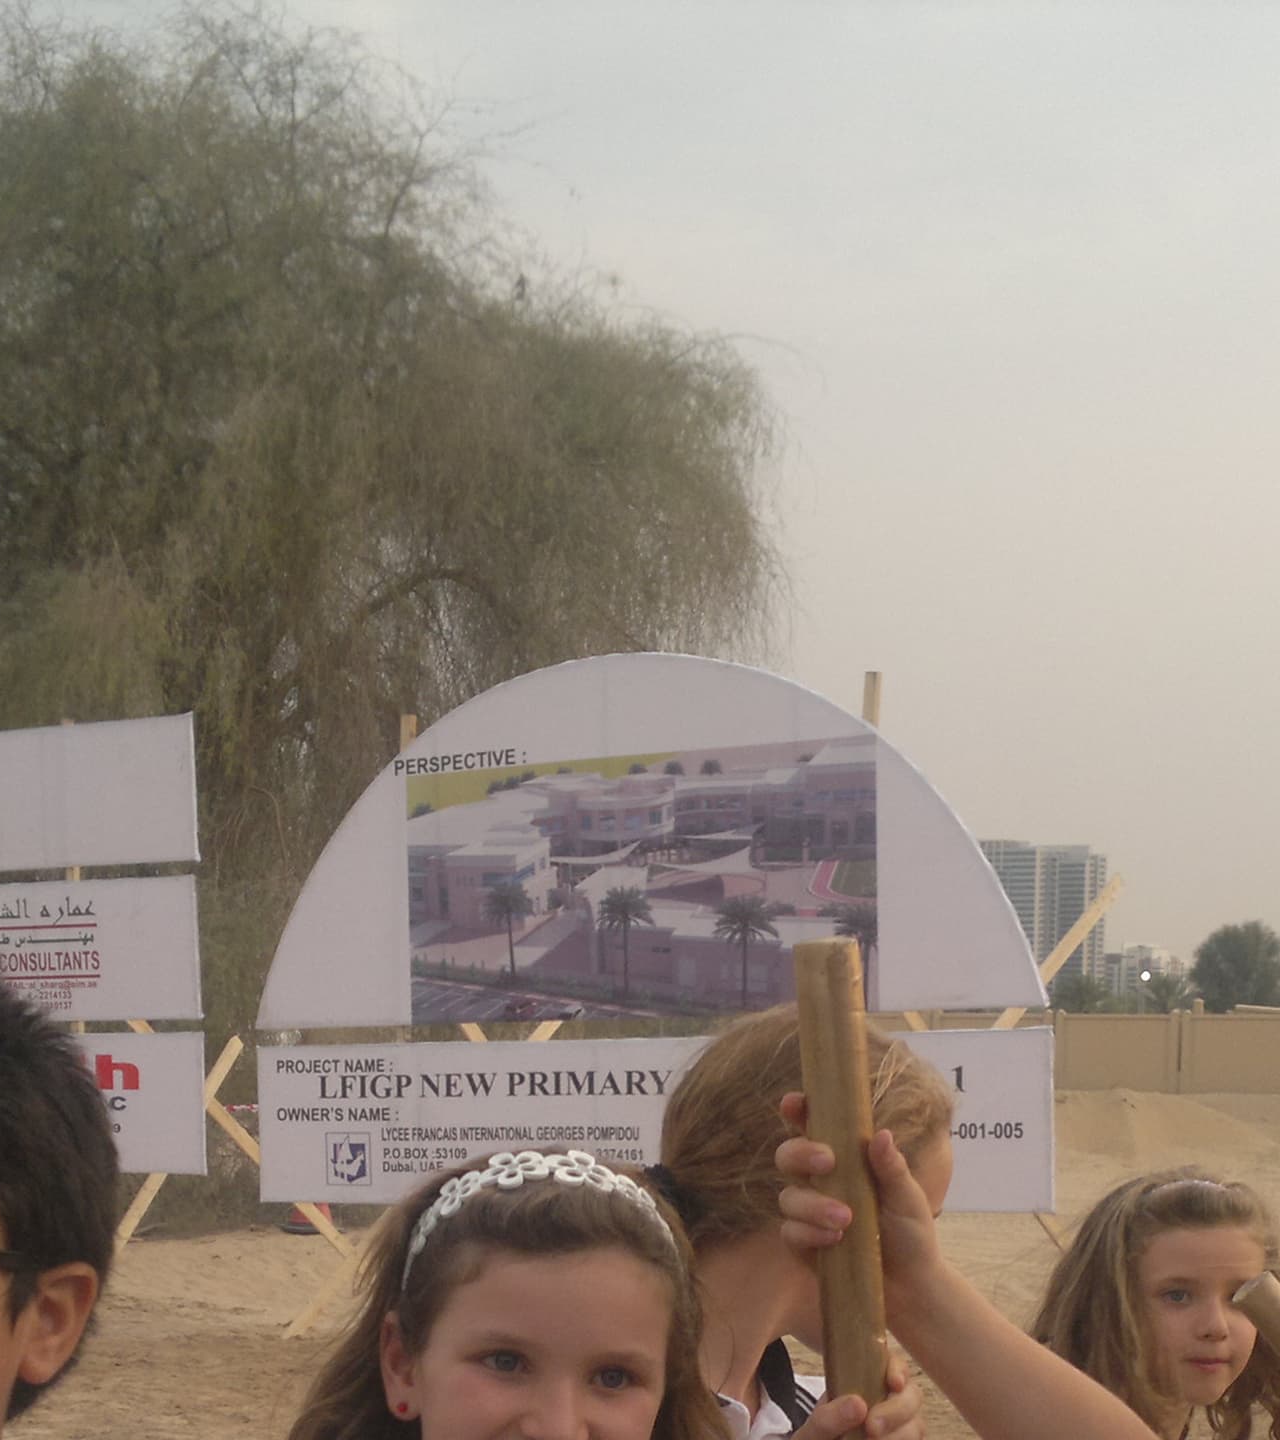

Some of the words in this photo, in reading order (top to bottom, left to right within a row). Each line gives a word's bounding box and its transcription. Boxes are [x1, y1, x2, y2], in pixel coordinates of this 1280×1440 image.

[394, 749, 516, 777] PERSPECTIVE
[0, 950, 100, 973] CONSULTANTS
[276, 1059, 341, 1074] PROJECT
[344, 1058, 385, 1073] NAME
[318, 1074, 413, 1100] LFIGP
[419, 1072, 498, 1098] NEW
[506, 1069, 673, 1097] PRIMARY
[276, 1107, 344, 1122] OWNER'S
[348, 1107, 391, 1122] NAME
[381, 1127, 411, 1142] LYCEE
[411, 1127, 458, 1142] FRANCAIS
[459, 1126, 535, 1142] INTERNATIONAL
[535, 1126, 585, 1142] GEORGES
[586, 1125, 640, 1142] POMPIDOU
[948, 1121, 1024, 1140] -001-005
[382, 1160, 417, 1174] Dubai,
